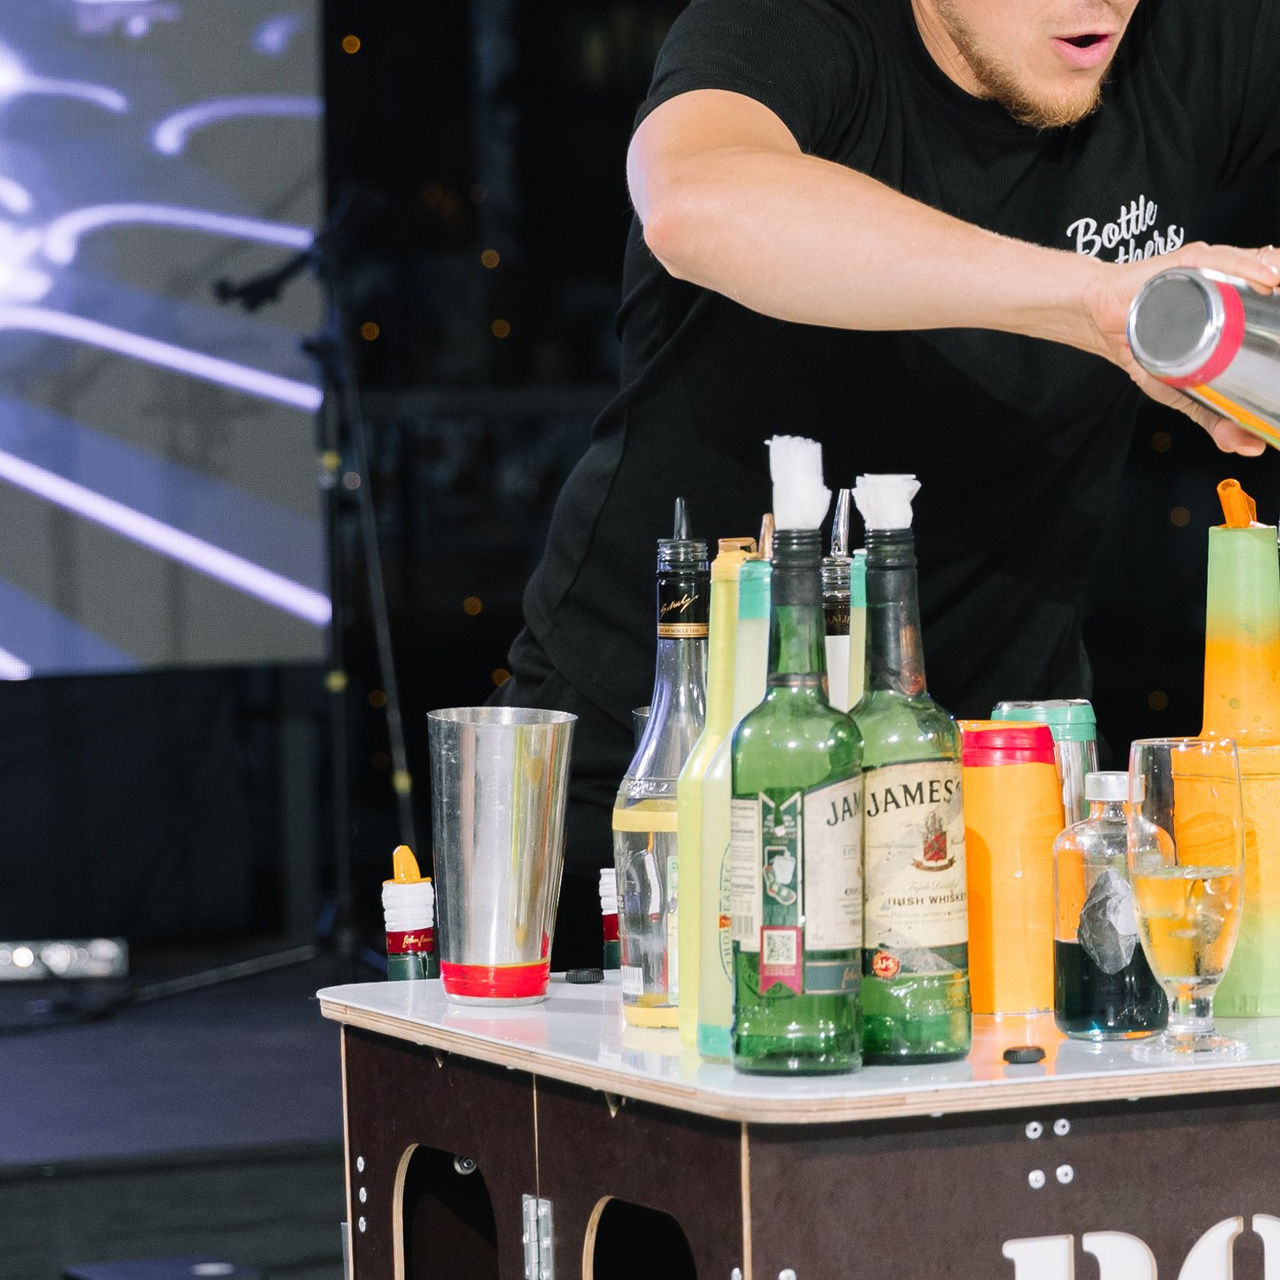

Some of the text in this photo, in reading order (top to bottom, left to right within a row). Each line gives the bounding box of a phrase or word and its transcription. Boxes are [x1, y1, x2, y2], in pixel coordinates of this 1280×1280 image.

[1066, 194, 1159, 258] Bottle
[1114, 224, 1185, 266] thers
[866, 779, 961, 818] JAMES
